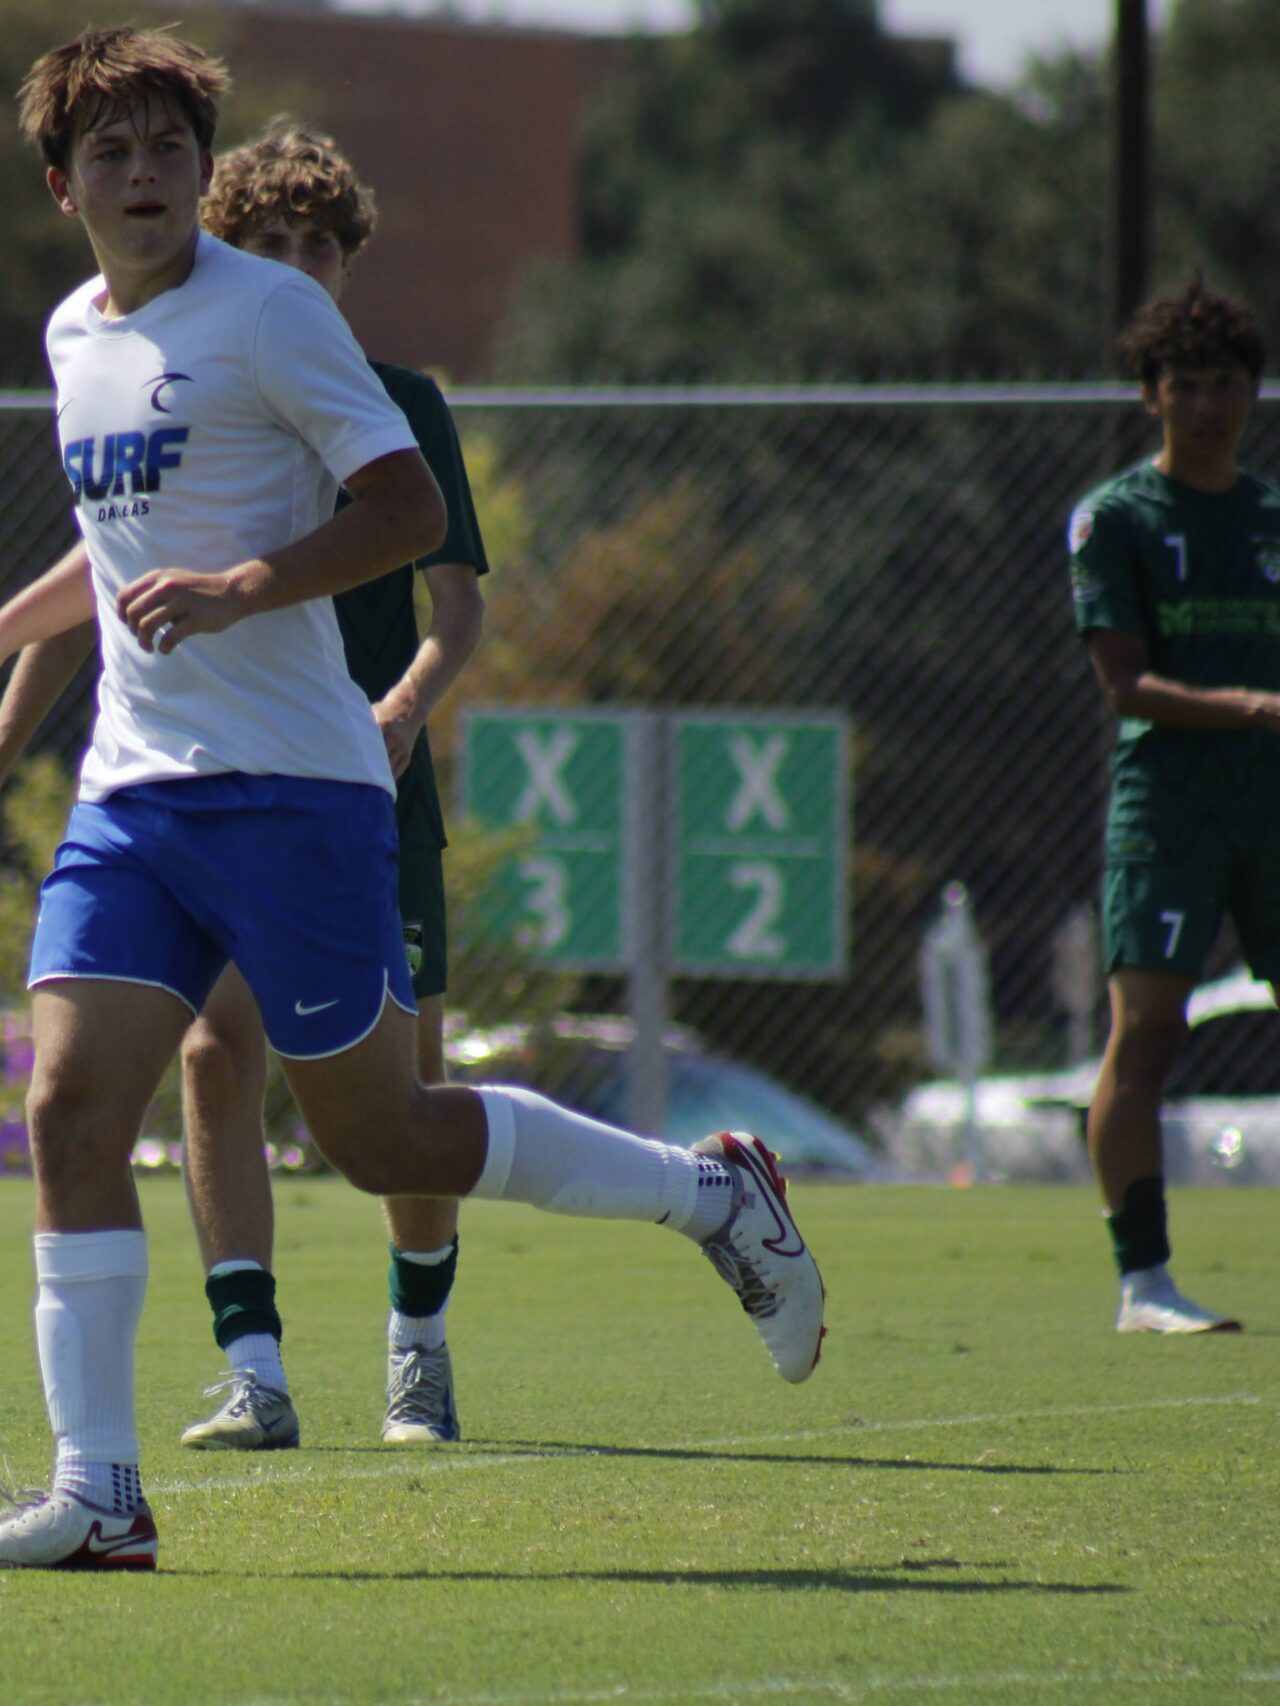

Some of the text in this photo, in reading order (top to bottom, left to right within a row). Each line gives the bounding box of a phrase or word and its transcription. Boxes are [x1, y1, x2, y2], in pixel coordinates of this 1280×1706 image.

[63, 426, 190, 502] SURF
[96, 501, 150, 523] DALLAS
[1164, 534, 1186, 582] 7
[515, 729, 578, 824] X
[724, 733, 788, 831] X
[516, 855, 570, 948] 3
[724, 860, 786, 957] 2
[1159, 910, 1185, 960] 7
